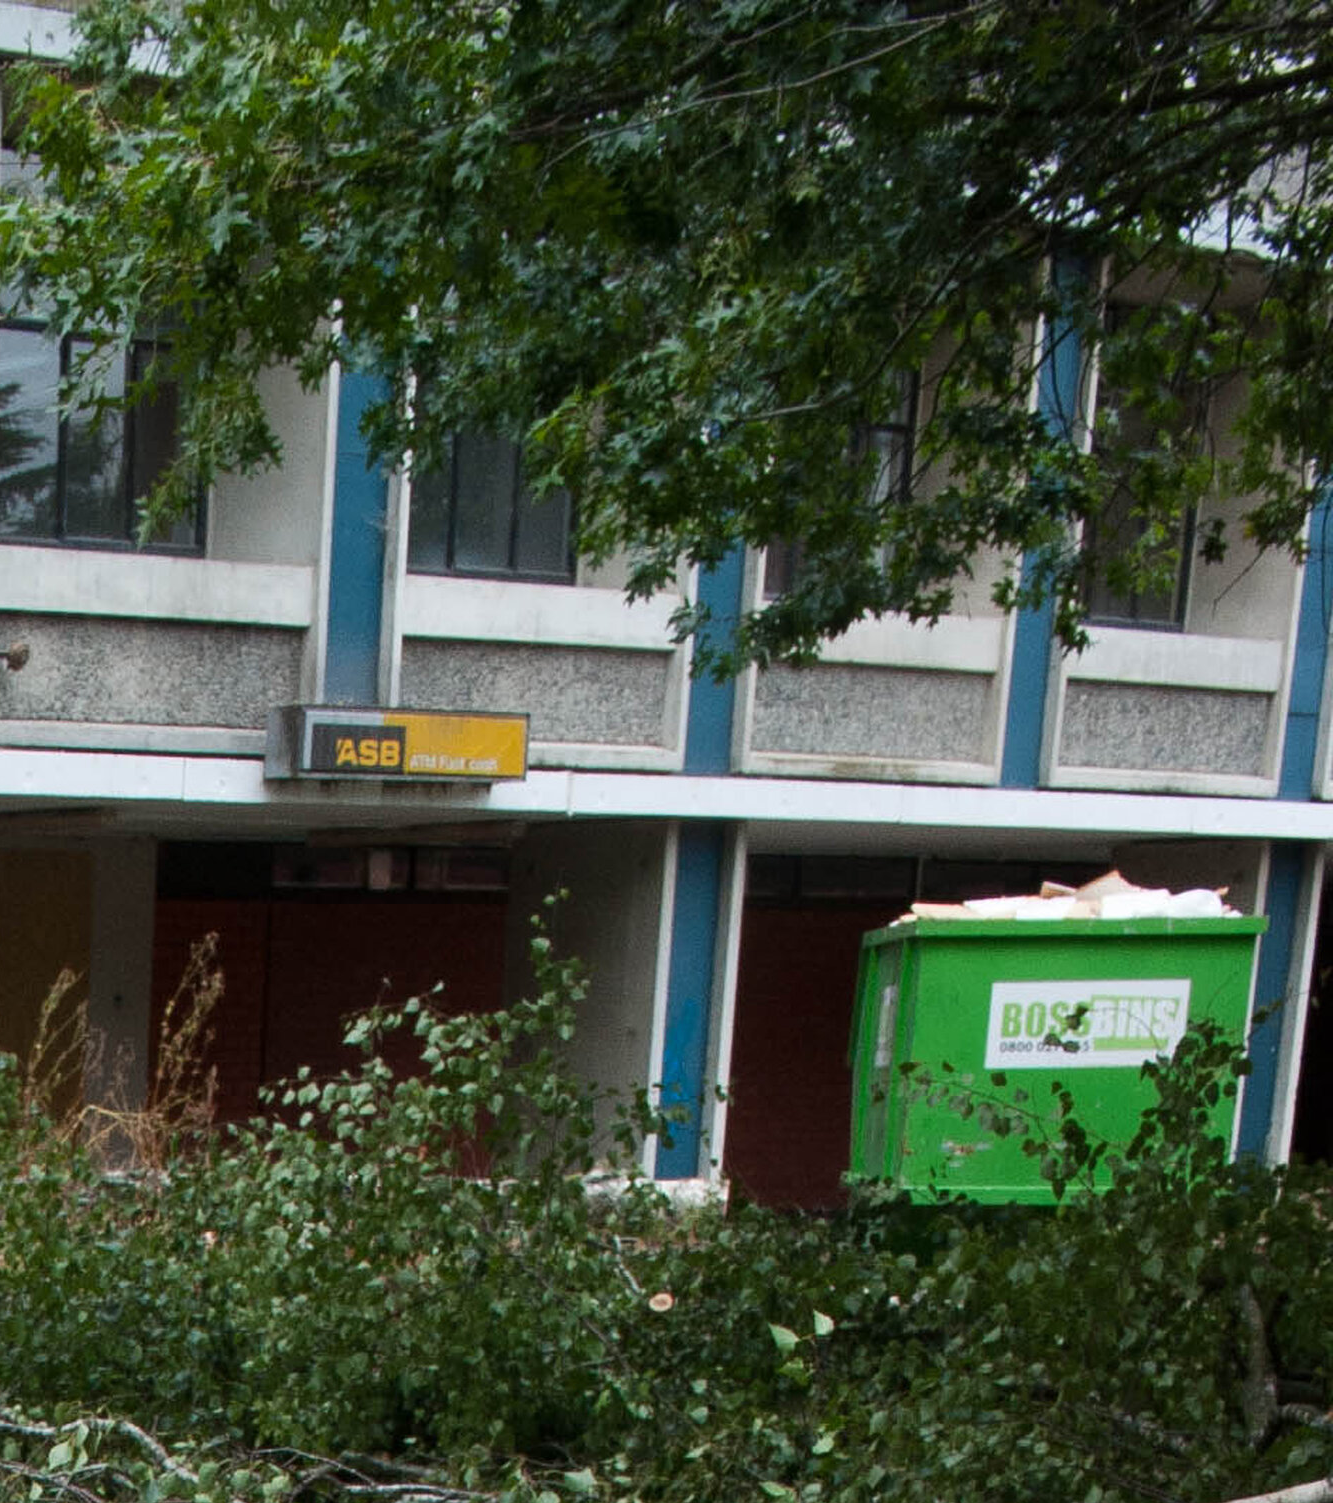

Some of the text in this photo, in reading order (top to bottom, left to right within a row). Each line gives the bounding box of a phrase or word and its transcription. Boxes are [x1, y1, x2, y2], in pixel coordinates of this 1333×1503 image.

[336, 738, 401, 767] ASB
[1090, 997, 1178, 1039] BINS
[999, 1041, 1033, 1053] 0800
